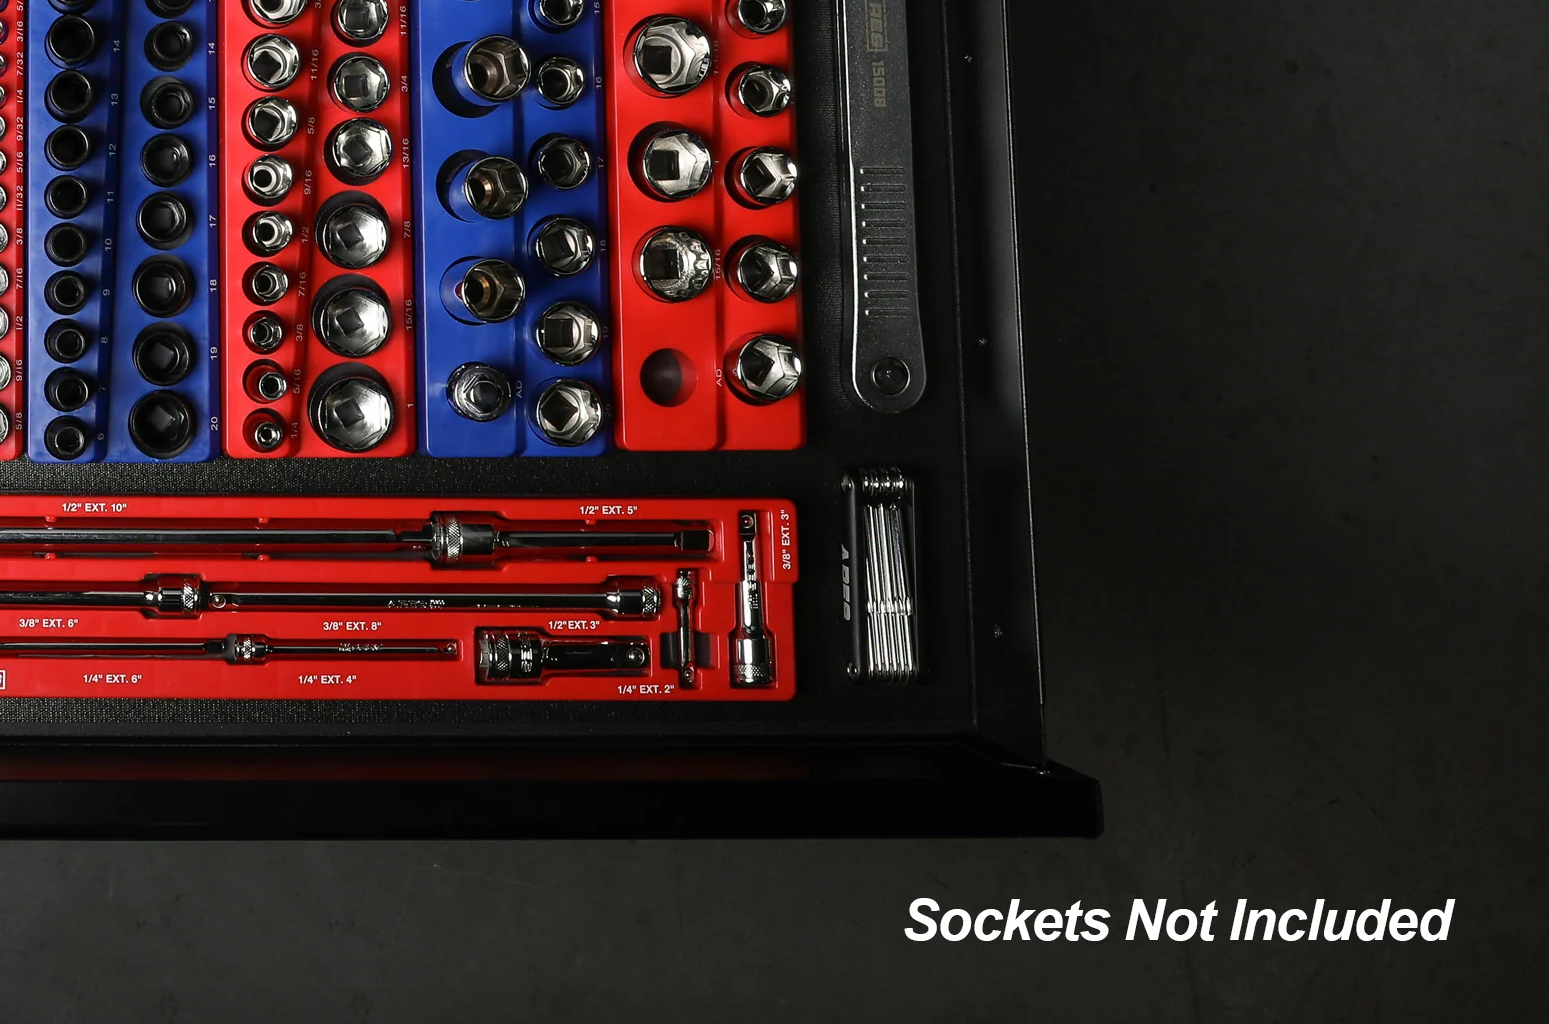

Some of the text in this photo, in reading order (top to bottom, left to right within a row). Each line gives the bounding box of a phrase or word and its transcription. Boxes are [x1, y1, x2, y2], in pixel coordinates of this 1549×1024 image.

[208, 42, 216, 55] 14
[311, 49, 319, 80] 11/16
[208, 97, 216, 110] 15
[308, 117, 316, 134] 5/8
[209, 154, 217, 167] 16
[304, 169, 312, 195] 9/16
[16, 185, 24, 211] 11/32
[209, 215, 217, 228] 17
[16, 227, 24, 245] 3/8
[404, 221, 412, 238] 7/8
[16, 267, 24, 289] 7/16
[210, 279, 217, 292] 18
[16, 315, 24, 331] 1/2
[210, 347, 218, 360] 19
[716, 368, 723, 387] AD
[516, 381, 523, 398] AD
[211, 416, 218, 430] 20
[62, 503, 127, 513] 1/2" EXT. 10"
[579, 505, 637, 516] 1/2" EXT. 5"
[780, 509, 792, 569] 3/8" EXT. 3"
[19, 618, 78, 629] 3/8" EXT. 6"
[323, 622, 381, 632] 3/8" EXT. 8"
[548, 621, 600, 630] 1/2" EXT. 3"
[83, 674, 142, 684] 1/4" EXT. 6"
[299, 675, 356, 685] 1/4" EXT. 4"
[617, 685, 674, 695] 1/4" EXT. 2"
